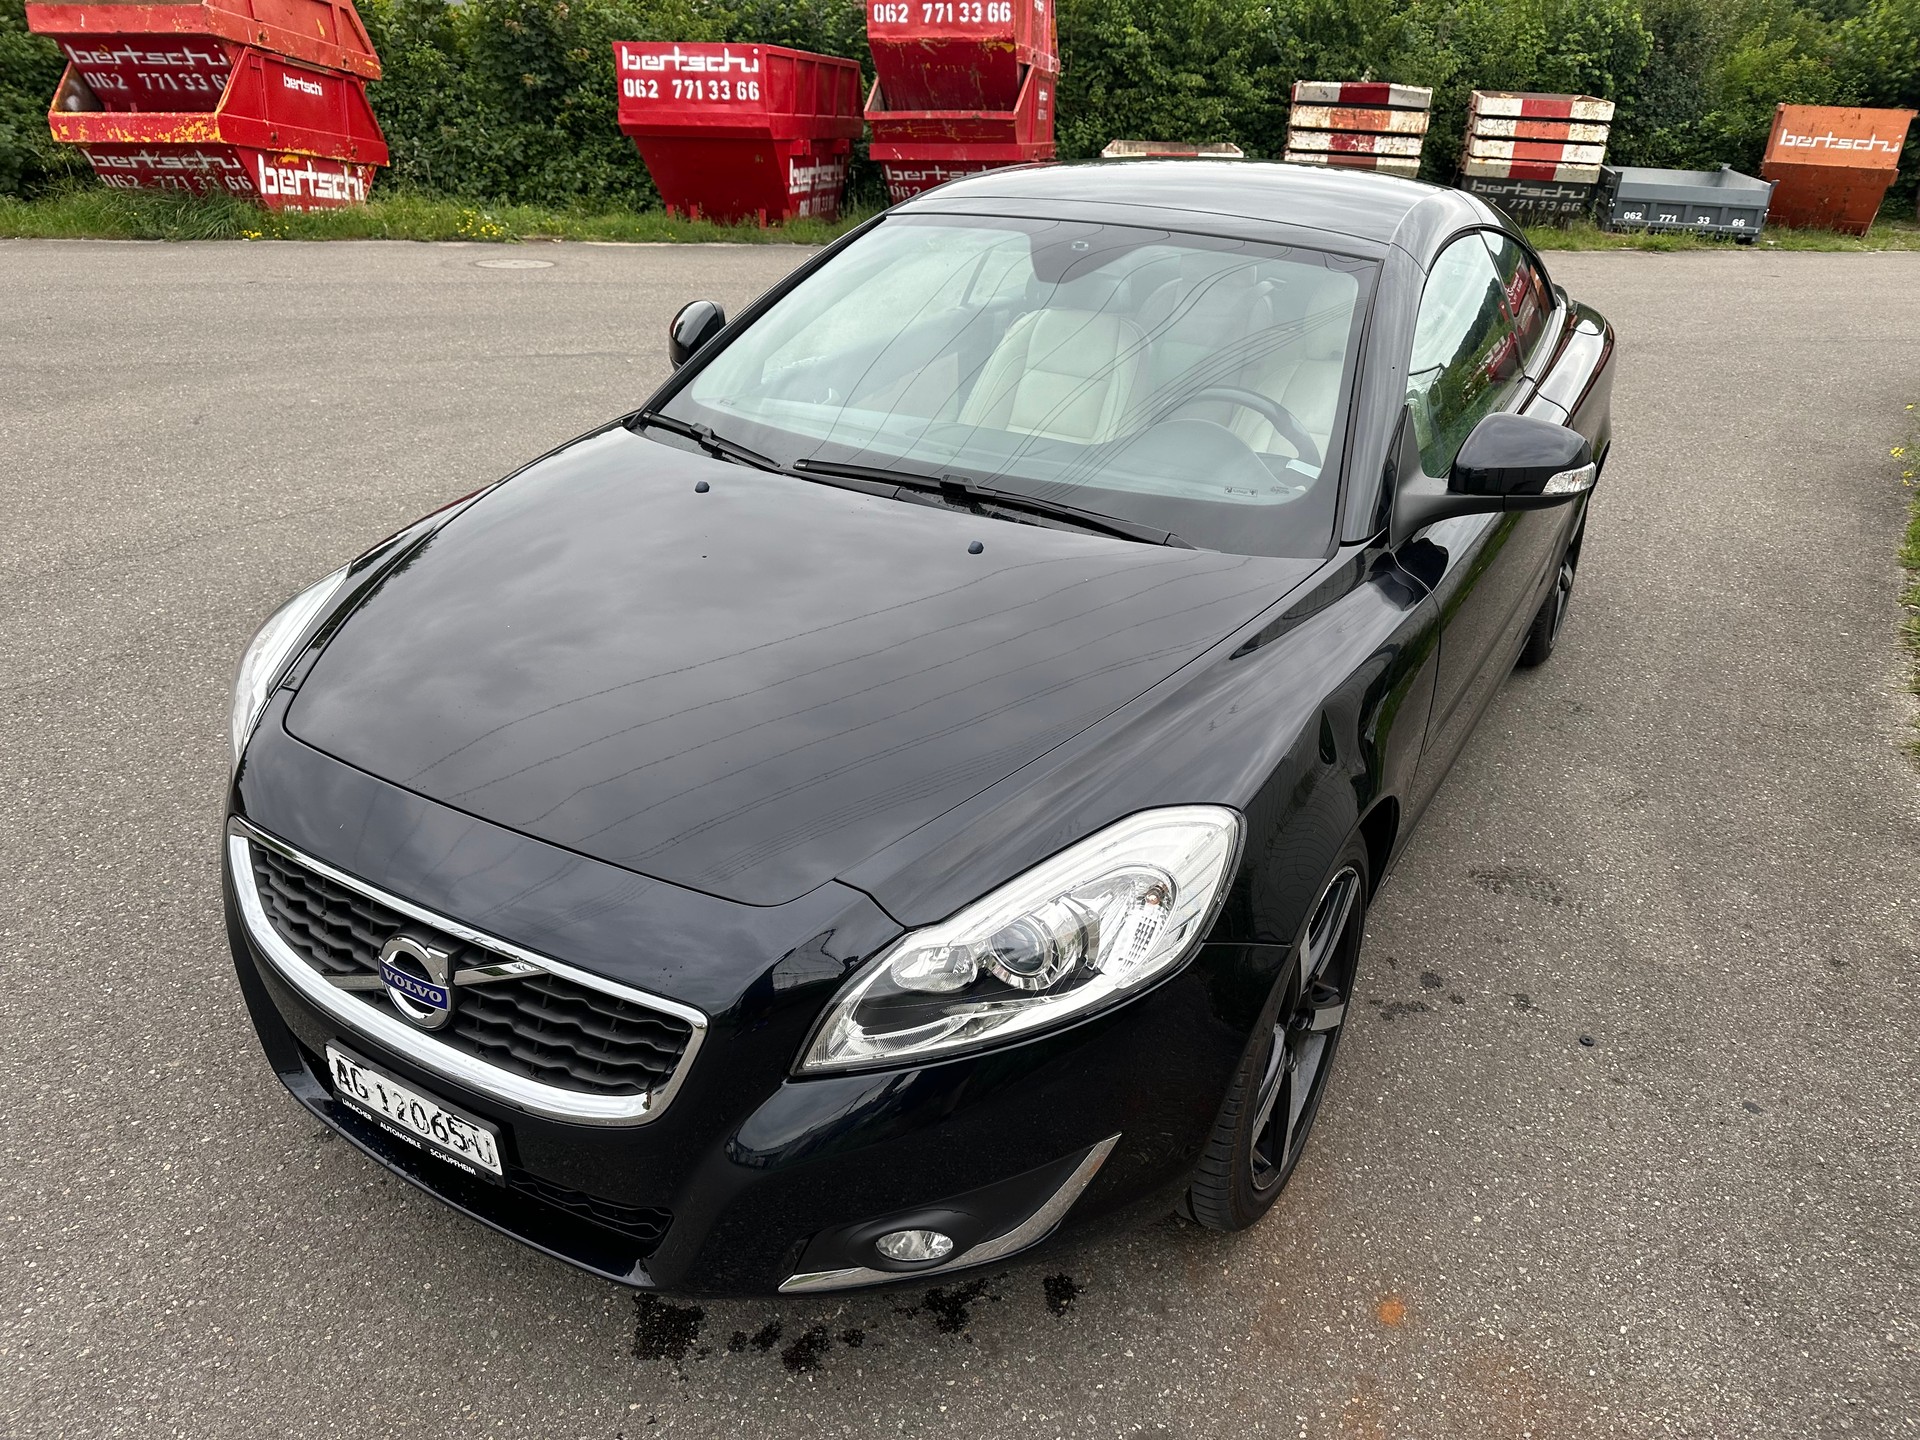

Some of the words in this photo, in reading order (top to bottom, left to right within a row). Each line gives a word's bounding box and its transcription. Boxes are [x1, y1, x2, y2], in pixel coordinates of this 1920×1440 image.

[873, 3, 909, 23] 062
[922, 3, 953, 23] 771
[959, 2, 982, 23] 33
[987, 2, 1011, 23] 66
[64, 44, 229, 65] bertschi
[621, 45, 760, 73] bertschi
[84, 72, 128, 90] 062
[137, 73, 179, 90] 771
[179, 73, 208, 91] 33
[211, 74, 228, 91] 6
[283, 72, 323, 96] bertschi
[623, 78, 659, 98] 062
[672, 79, 703, 99] 771
[708, 80, 731, 100] 33
[736, 81, 760, 100] 66
[1780, 128, 1902, 153] bertschi
[81, 147, 241, 169] bertschi
[258, 153, 365, 201] bertschi
[1471, 179, 1587, 199] bertschi
[1561, 202, 1581, 213] 66
[1623, 211, 1642, 220] 062
[1659, 214, 1677, 223] 771
[1697, 216, 1710, 225] 33
[1732, 218, 1745, 227] 66
[382, 966, 443, 1003] VOLVO
[379, 1121, 422, 1150] AUTOMOBILE
